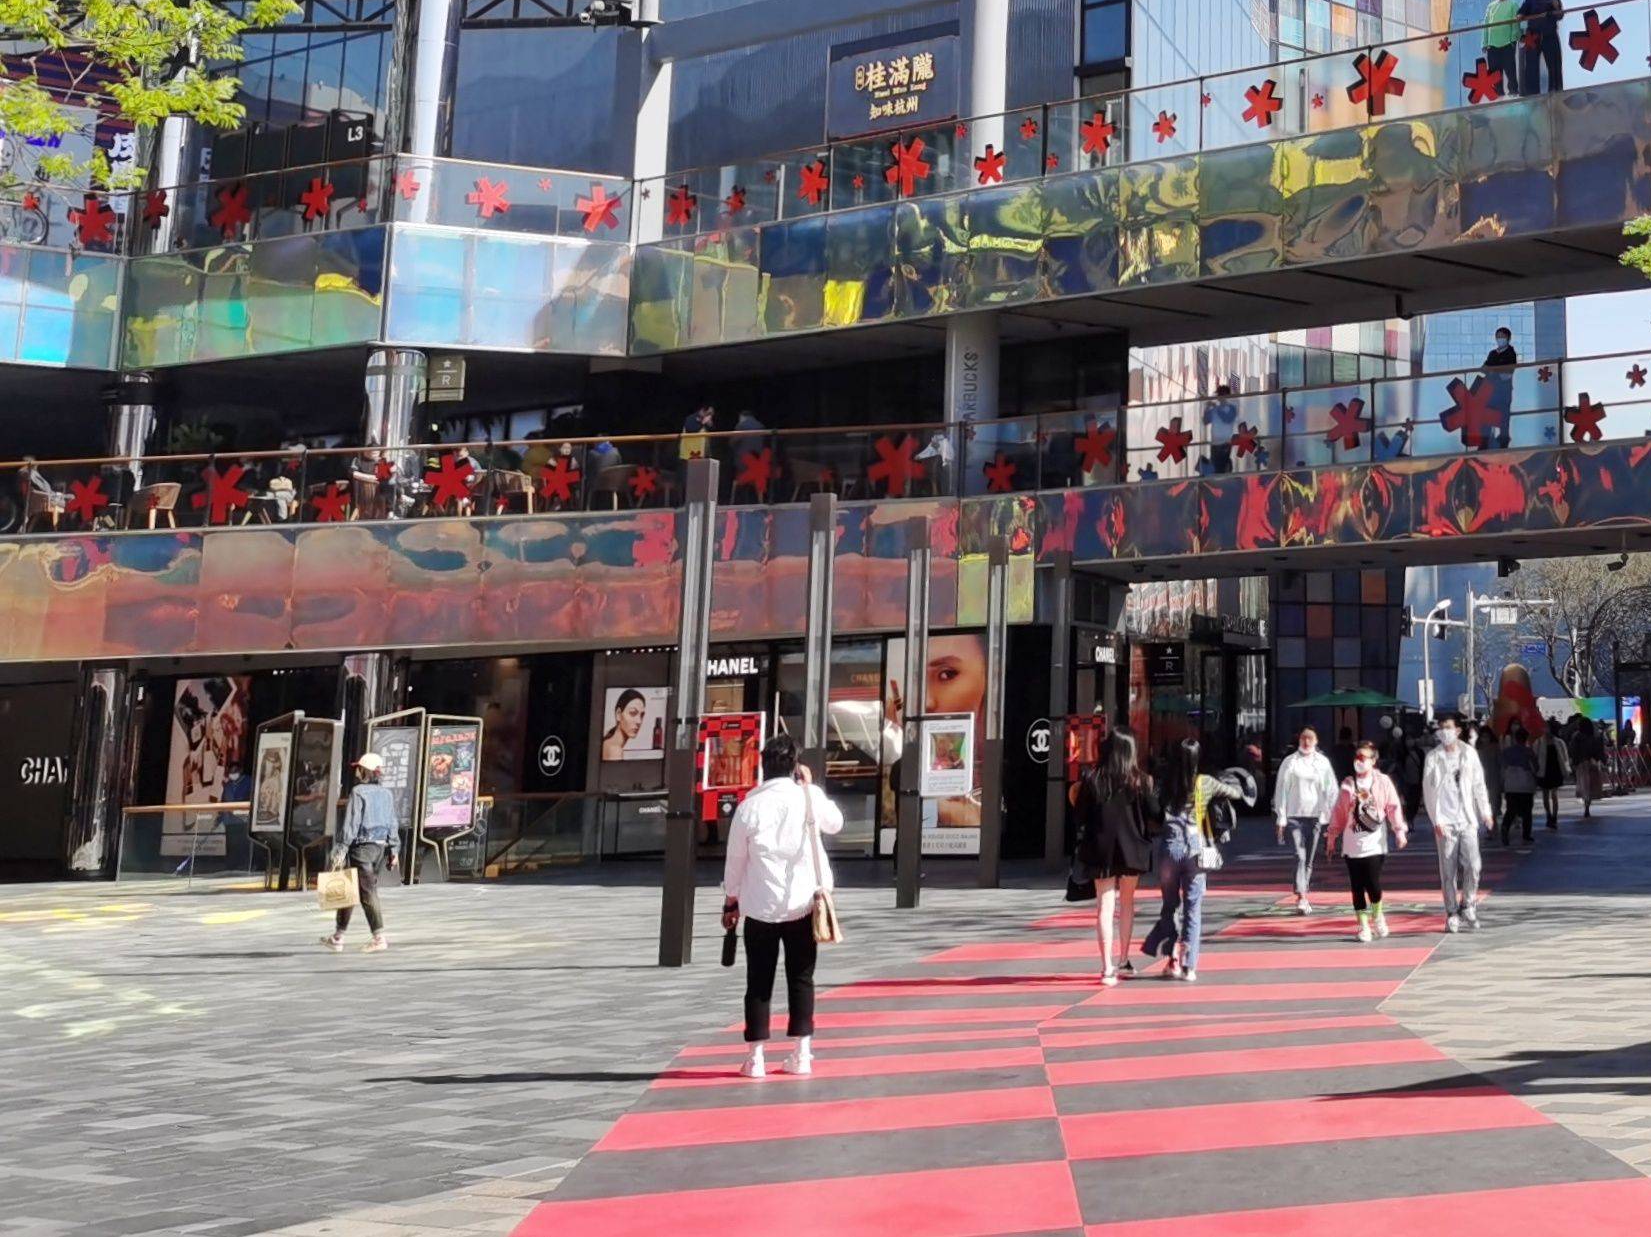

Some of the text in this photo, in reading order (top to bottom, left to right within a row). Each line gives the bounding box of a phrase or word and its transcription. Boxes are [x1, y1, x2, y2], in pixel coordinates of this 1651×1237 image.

[869, 95, 918, 120] 知味杭州
[347, 125, 364, 142] L3
[707, 658, 758, 676] HANEL
